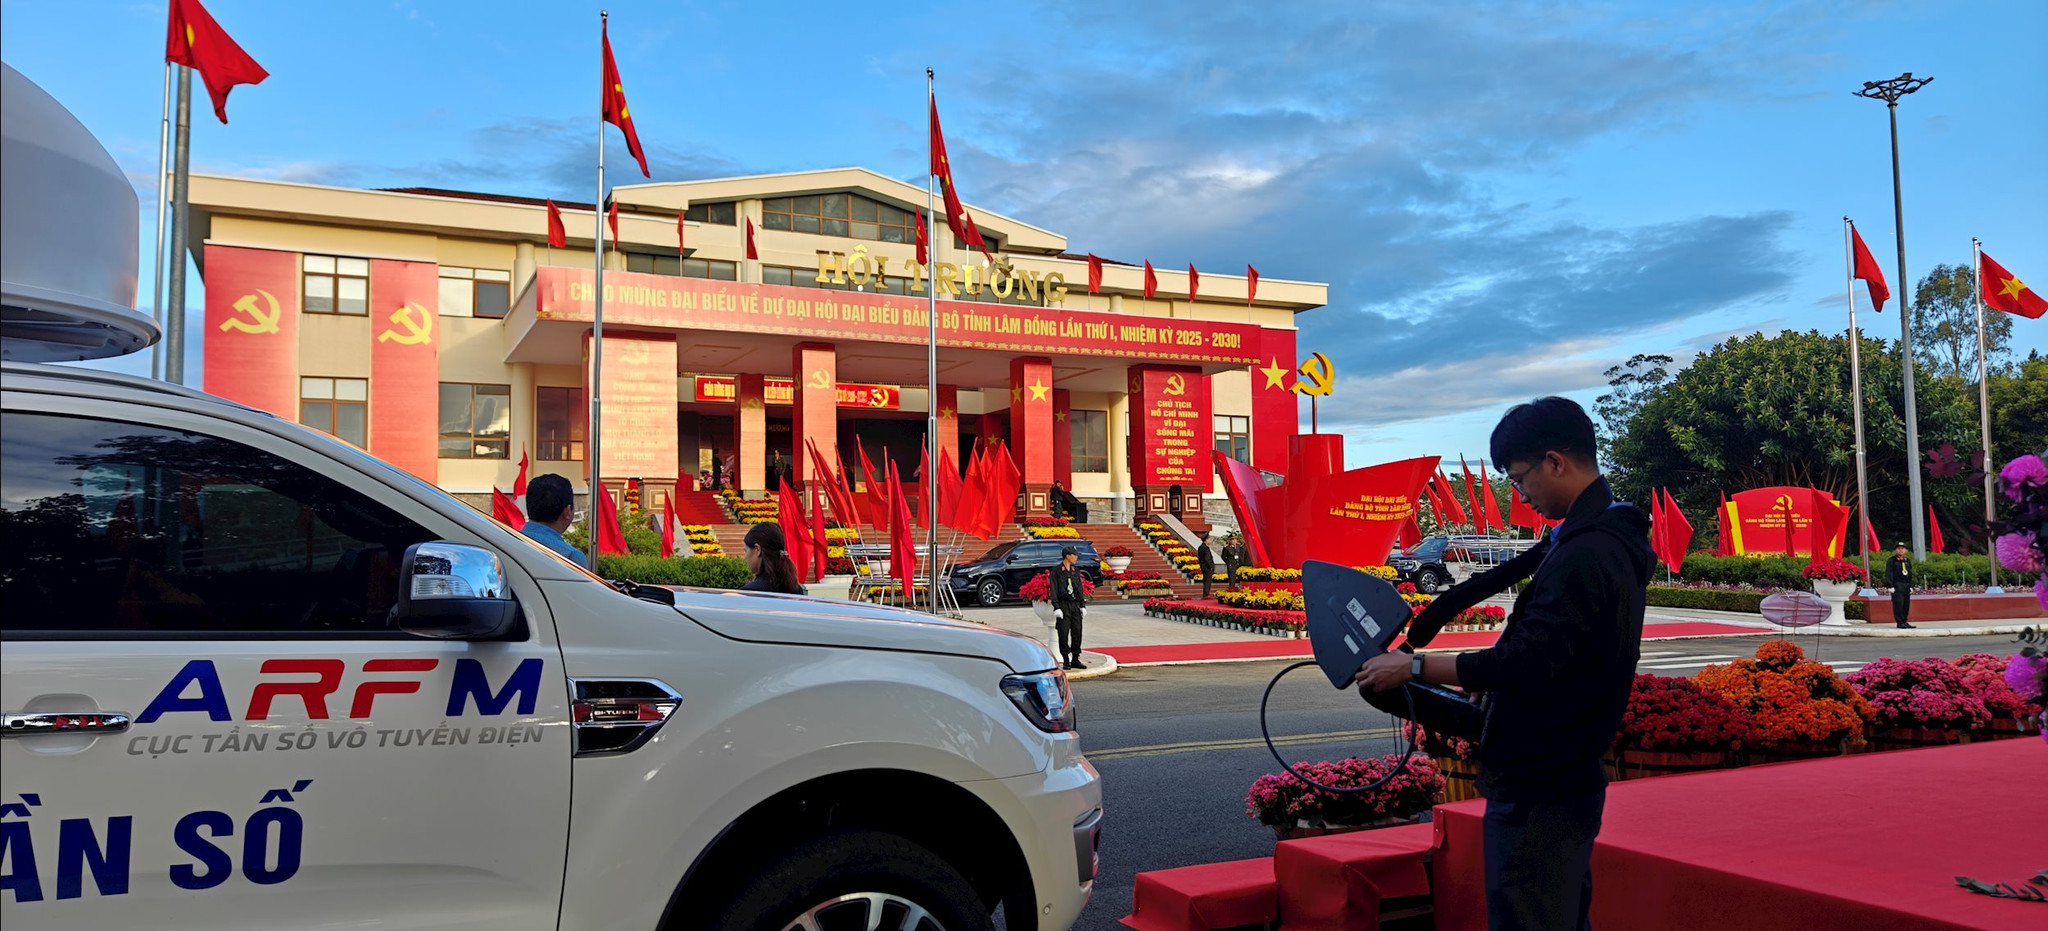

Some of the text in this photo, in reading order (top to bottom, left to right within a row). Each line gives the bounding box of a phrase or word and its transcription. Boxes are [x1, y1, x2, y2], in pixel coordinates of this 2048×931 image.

[815, 243, 1068, 303] HỘI TRƯỜNG
[570, 281, 614, 302] CHO
[619, 283, 666, 308] MỪNG
[672, 289, 698, 313] ĐẠI
[702, 287, 737, 313] BIỂU
[741, 290, 759, 314] VỀ
[763, 296, 784, 319] DỰ
[786, 298, 811, 321] ĐẠI
[815, 298, 838, 323] HỘI
[842, 303, 865, 325] ĐẠI
[869, 301, 899, 325] BIỂU
[942, 310, 960, 333] BỘ
[963, 309, 991, 332] TỈNH
[995, 313, 1020, 334] LÂM
[1024, 314, 1057, 337] ĐỒNG
[1060, 316, 1082, 338] LẦN
[1085, 320, 1108, 340] THỨ
[1120, 323, 1157, 346] NHIỆM
[1160, 326, 1173, 344] KỲ
[1176, 330, 1202, 346] 2025
[1212, 332, 1241, 349] 2030!
[1162, 438, 1188, 446] TRONG
[1184, 467, 1196, 475] TA!
[133, 658, 544, 723] ARFM
[126, 720, 544, 759] CỤC TẦN SỐ VÔ TUYẾN ĐIỆN
[169, 779, 314, 890] SỐ
